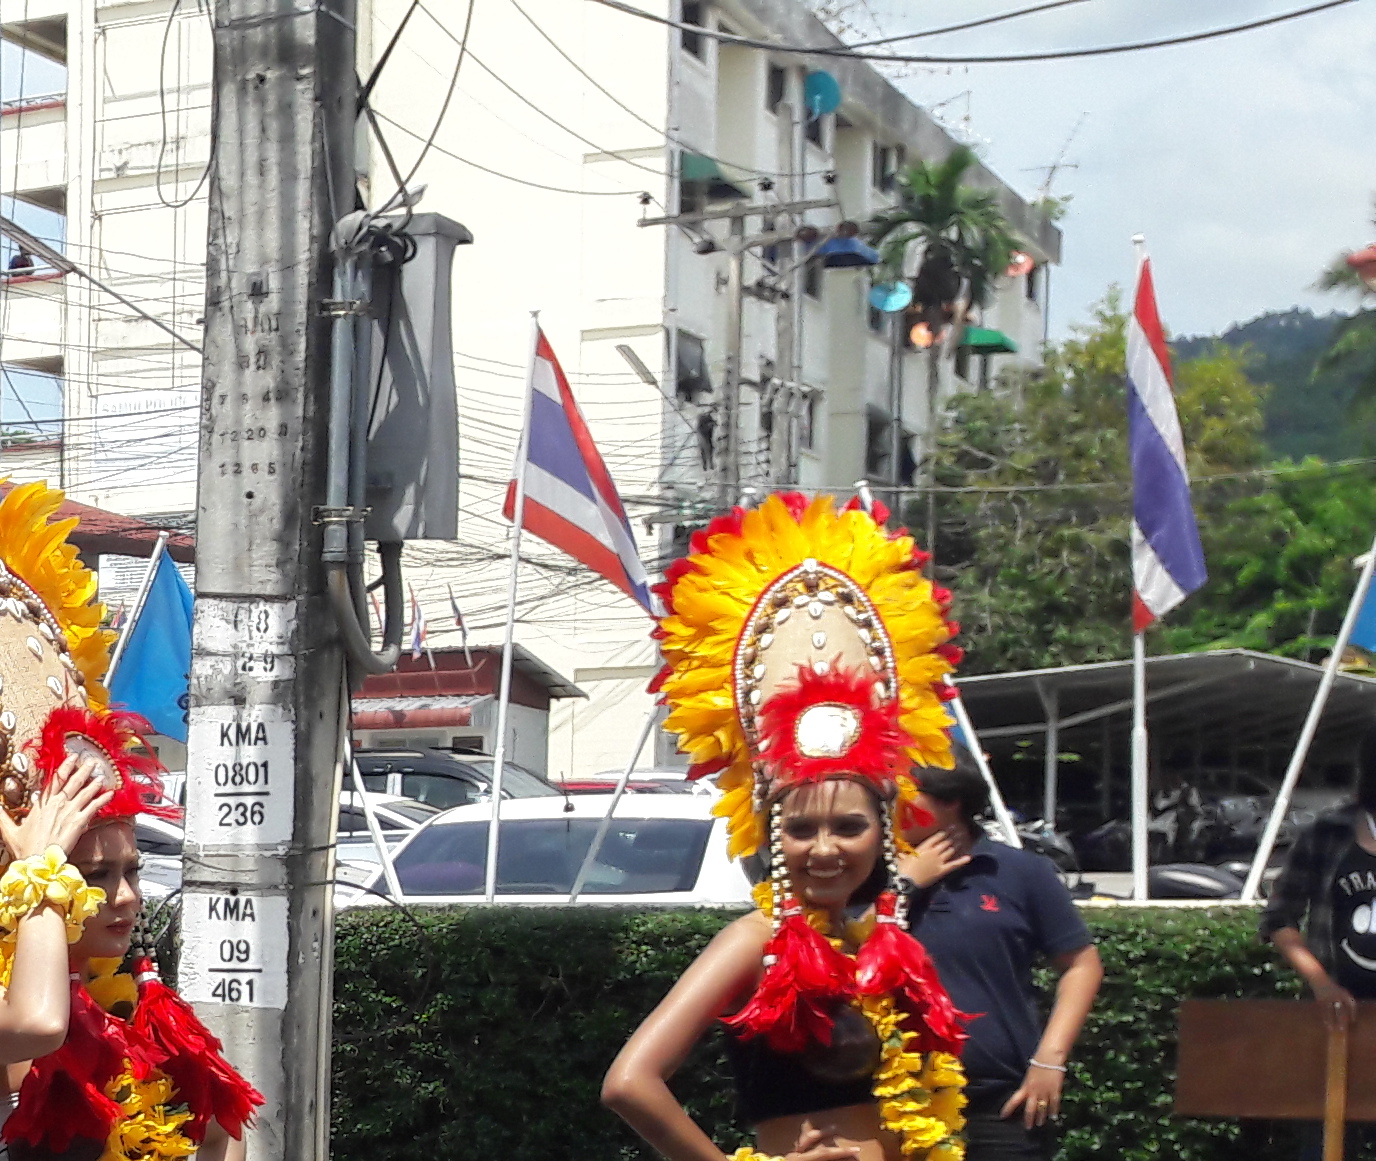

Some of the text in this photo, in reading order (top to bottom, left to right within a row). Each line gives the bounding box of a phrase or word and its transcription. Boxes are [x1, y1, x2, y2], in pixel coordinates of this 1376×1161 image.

[219, 722, 268, 747] KMA
[214, 760, 269, 787] 0801
[218, 801, 265, 827] 236
[208, 896, 256, 922] KMA
[219, 939, 251, 963] 09
[211, 978, 254, 1003] 461
